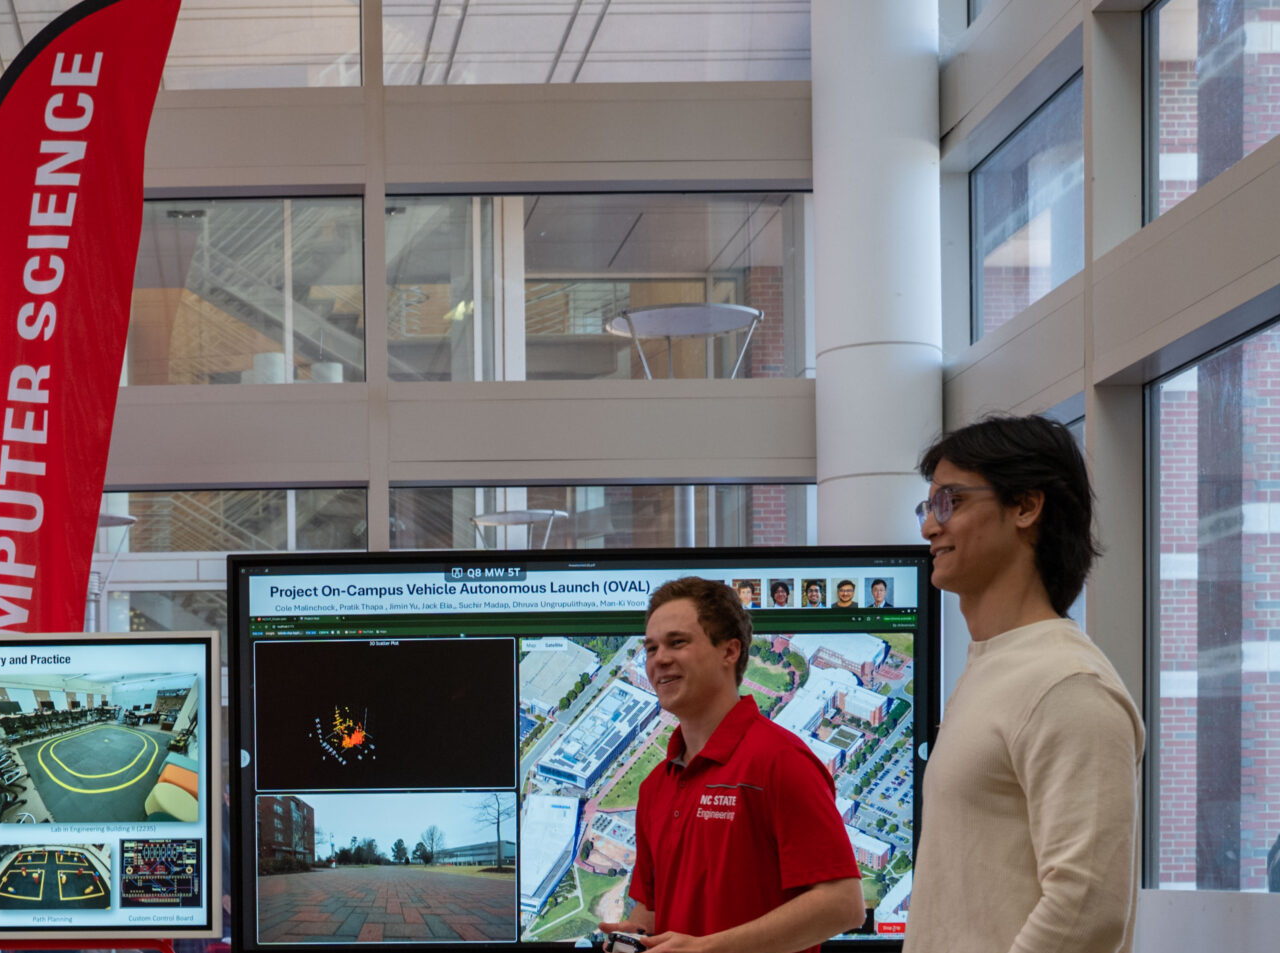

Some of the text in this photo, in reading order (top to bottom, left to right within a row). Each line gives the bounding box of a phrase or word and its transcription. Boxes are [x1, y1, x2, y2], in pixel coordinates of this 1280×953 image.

[16, 51, 104, 342] SCIENCE
[467, 568, 521, 578] Q8 MW 5T
[270, 580, 651, 600] Project On-Campus Vehicle Autonomous Launch (OVAL)
[9, 656, 28, 665] and
[31, 654, 71, 665] Practice
[700, 795, 737, 806] NC STATE
[696, 807, 736, 821] Engineering
